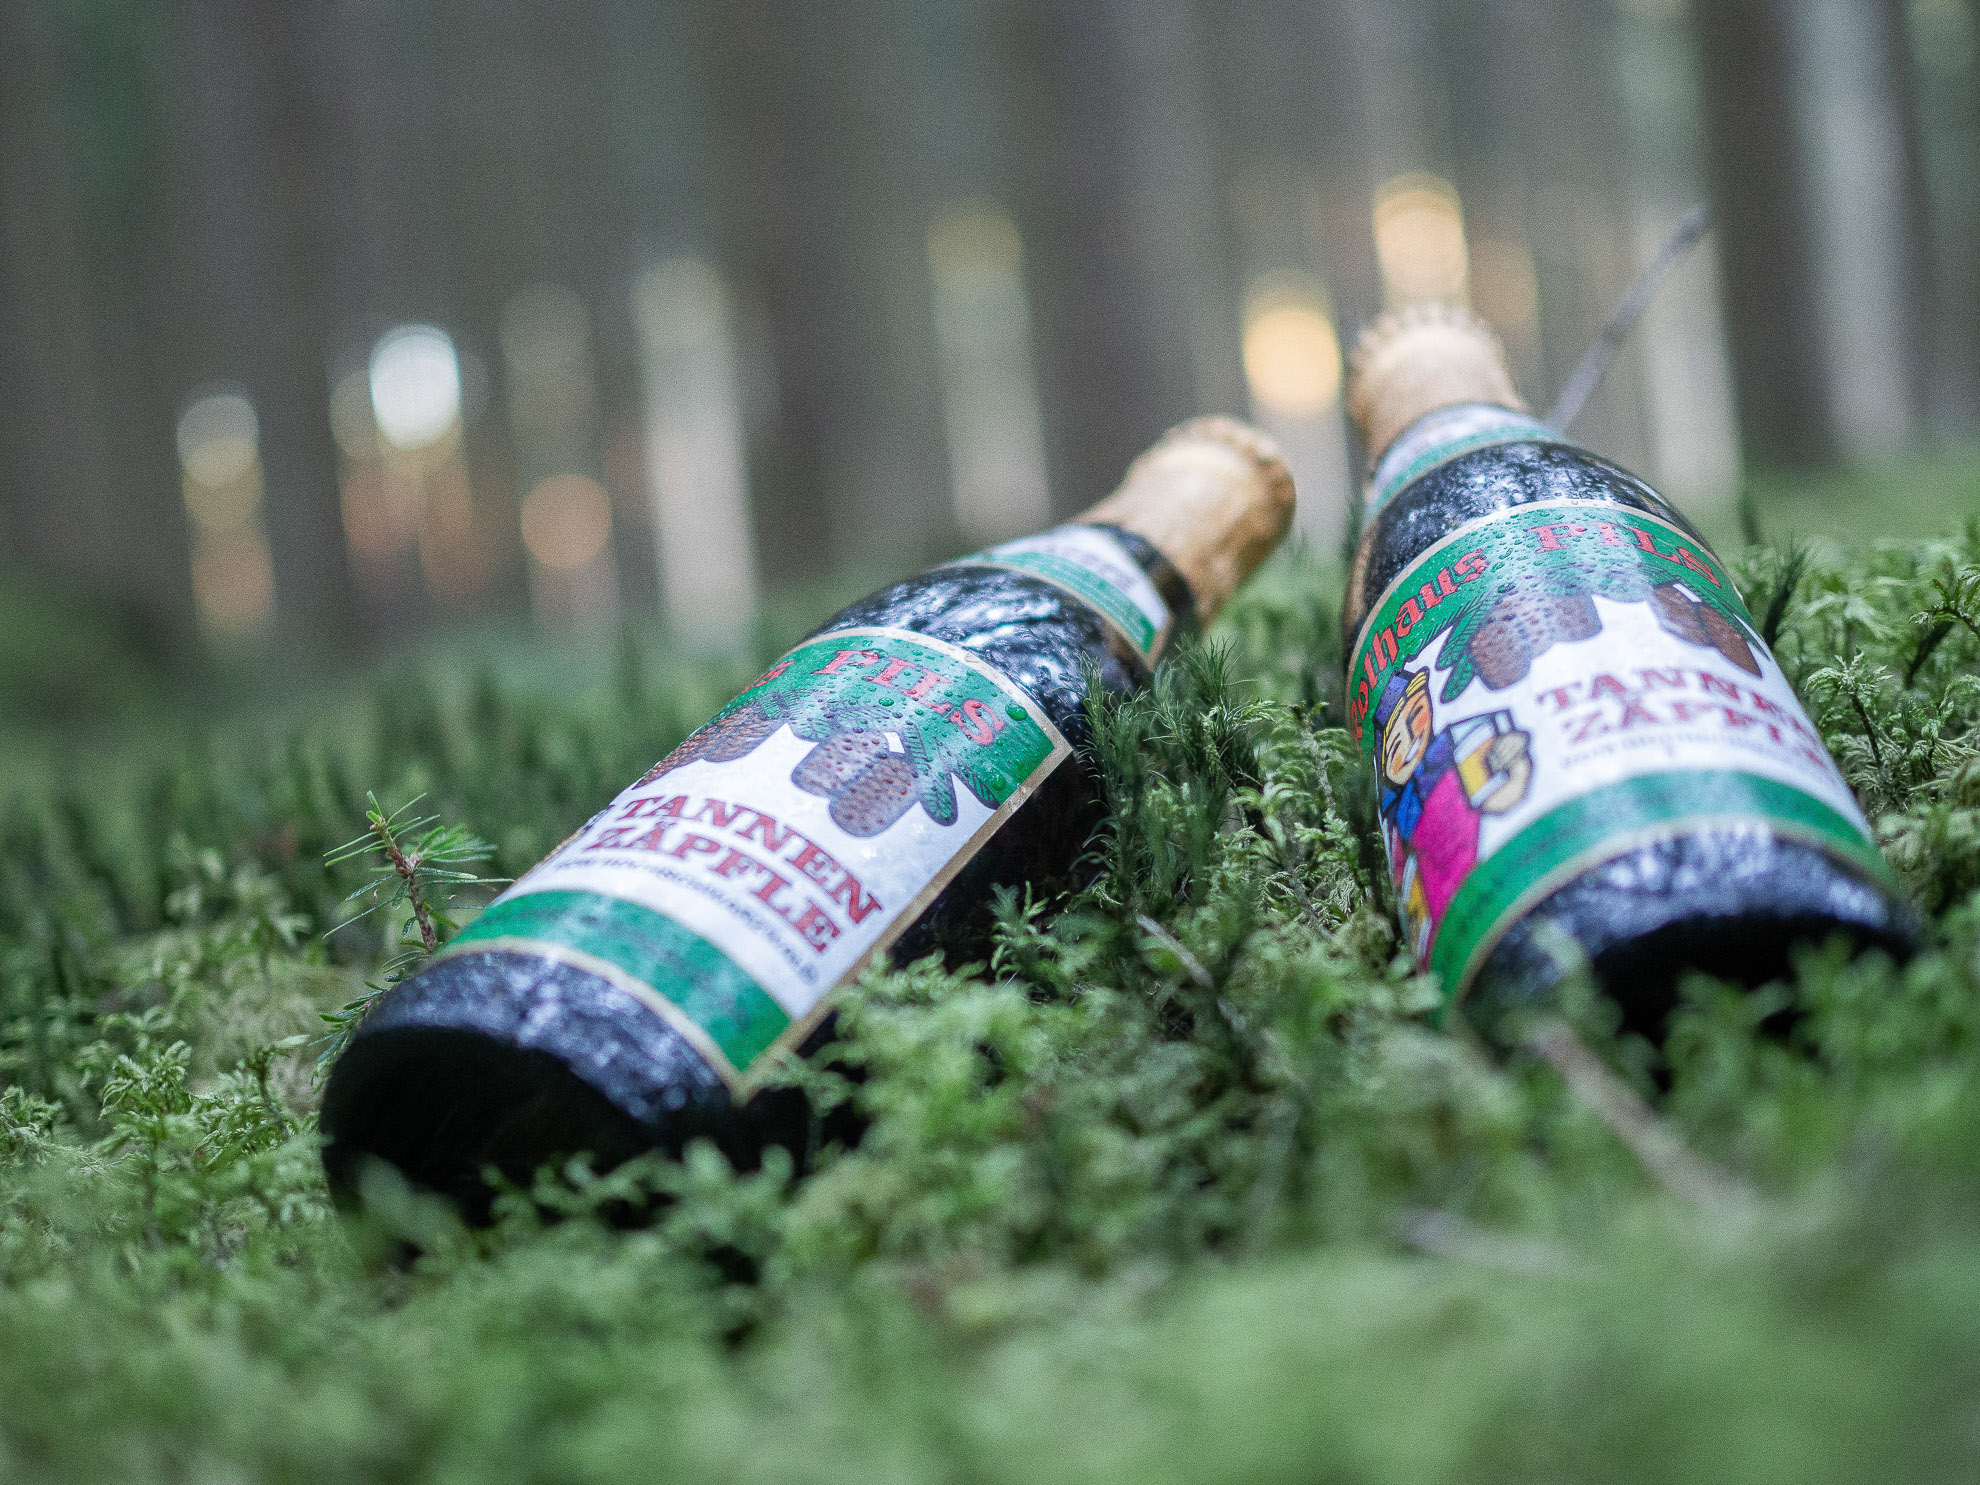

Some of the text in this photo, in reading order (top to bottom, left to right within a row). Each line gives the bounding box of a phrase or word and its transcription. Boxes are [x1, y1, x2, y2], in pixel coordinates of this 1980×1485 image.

[1525, 521, 1723, 589] PILS
[810, 650, 1005, 747] PILS
[584, 820, 842, 953] ZÄPFLE
[616, 795, 883, 926] TANNEN
